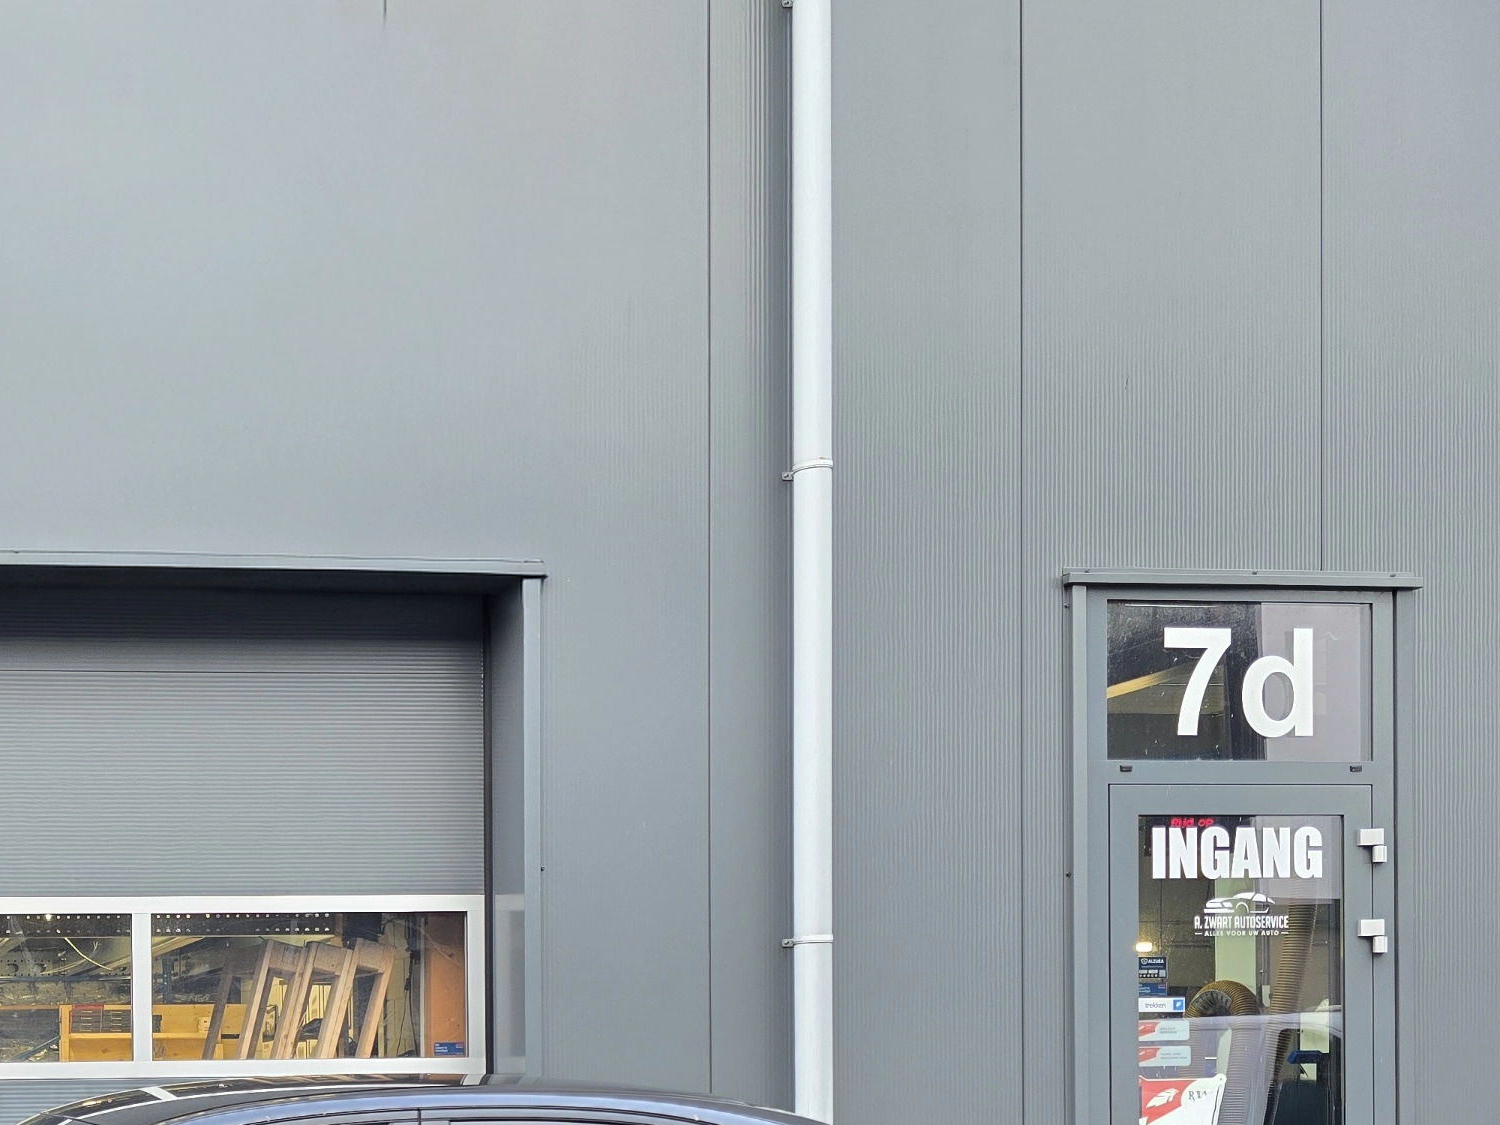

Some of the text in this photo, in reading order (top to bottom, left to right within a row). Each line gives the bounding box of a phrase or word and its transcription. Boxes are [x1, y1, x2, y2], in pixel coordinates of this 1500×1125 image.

[1163, 626, 1314, 738] 7d
[1151, 826, 1323, 880] INGANG
[1194, 915, 1289, 929] A. ZWART AUTOSERVICE
